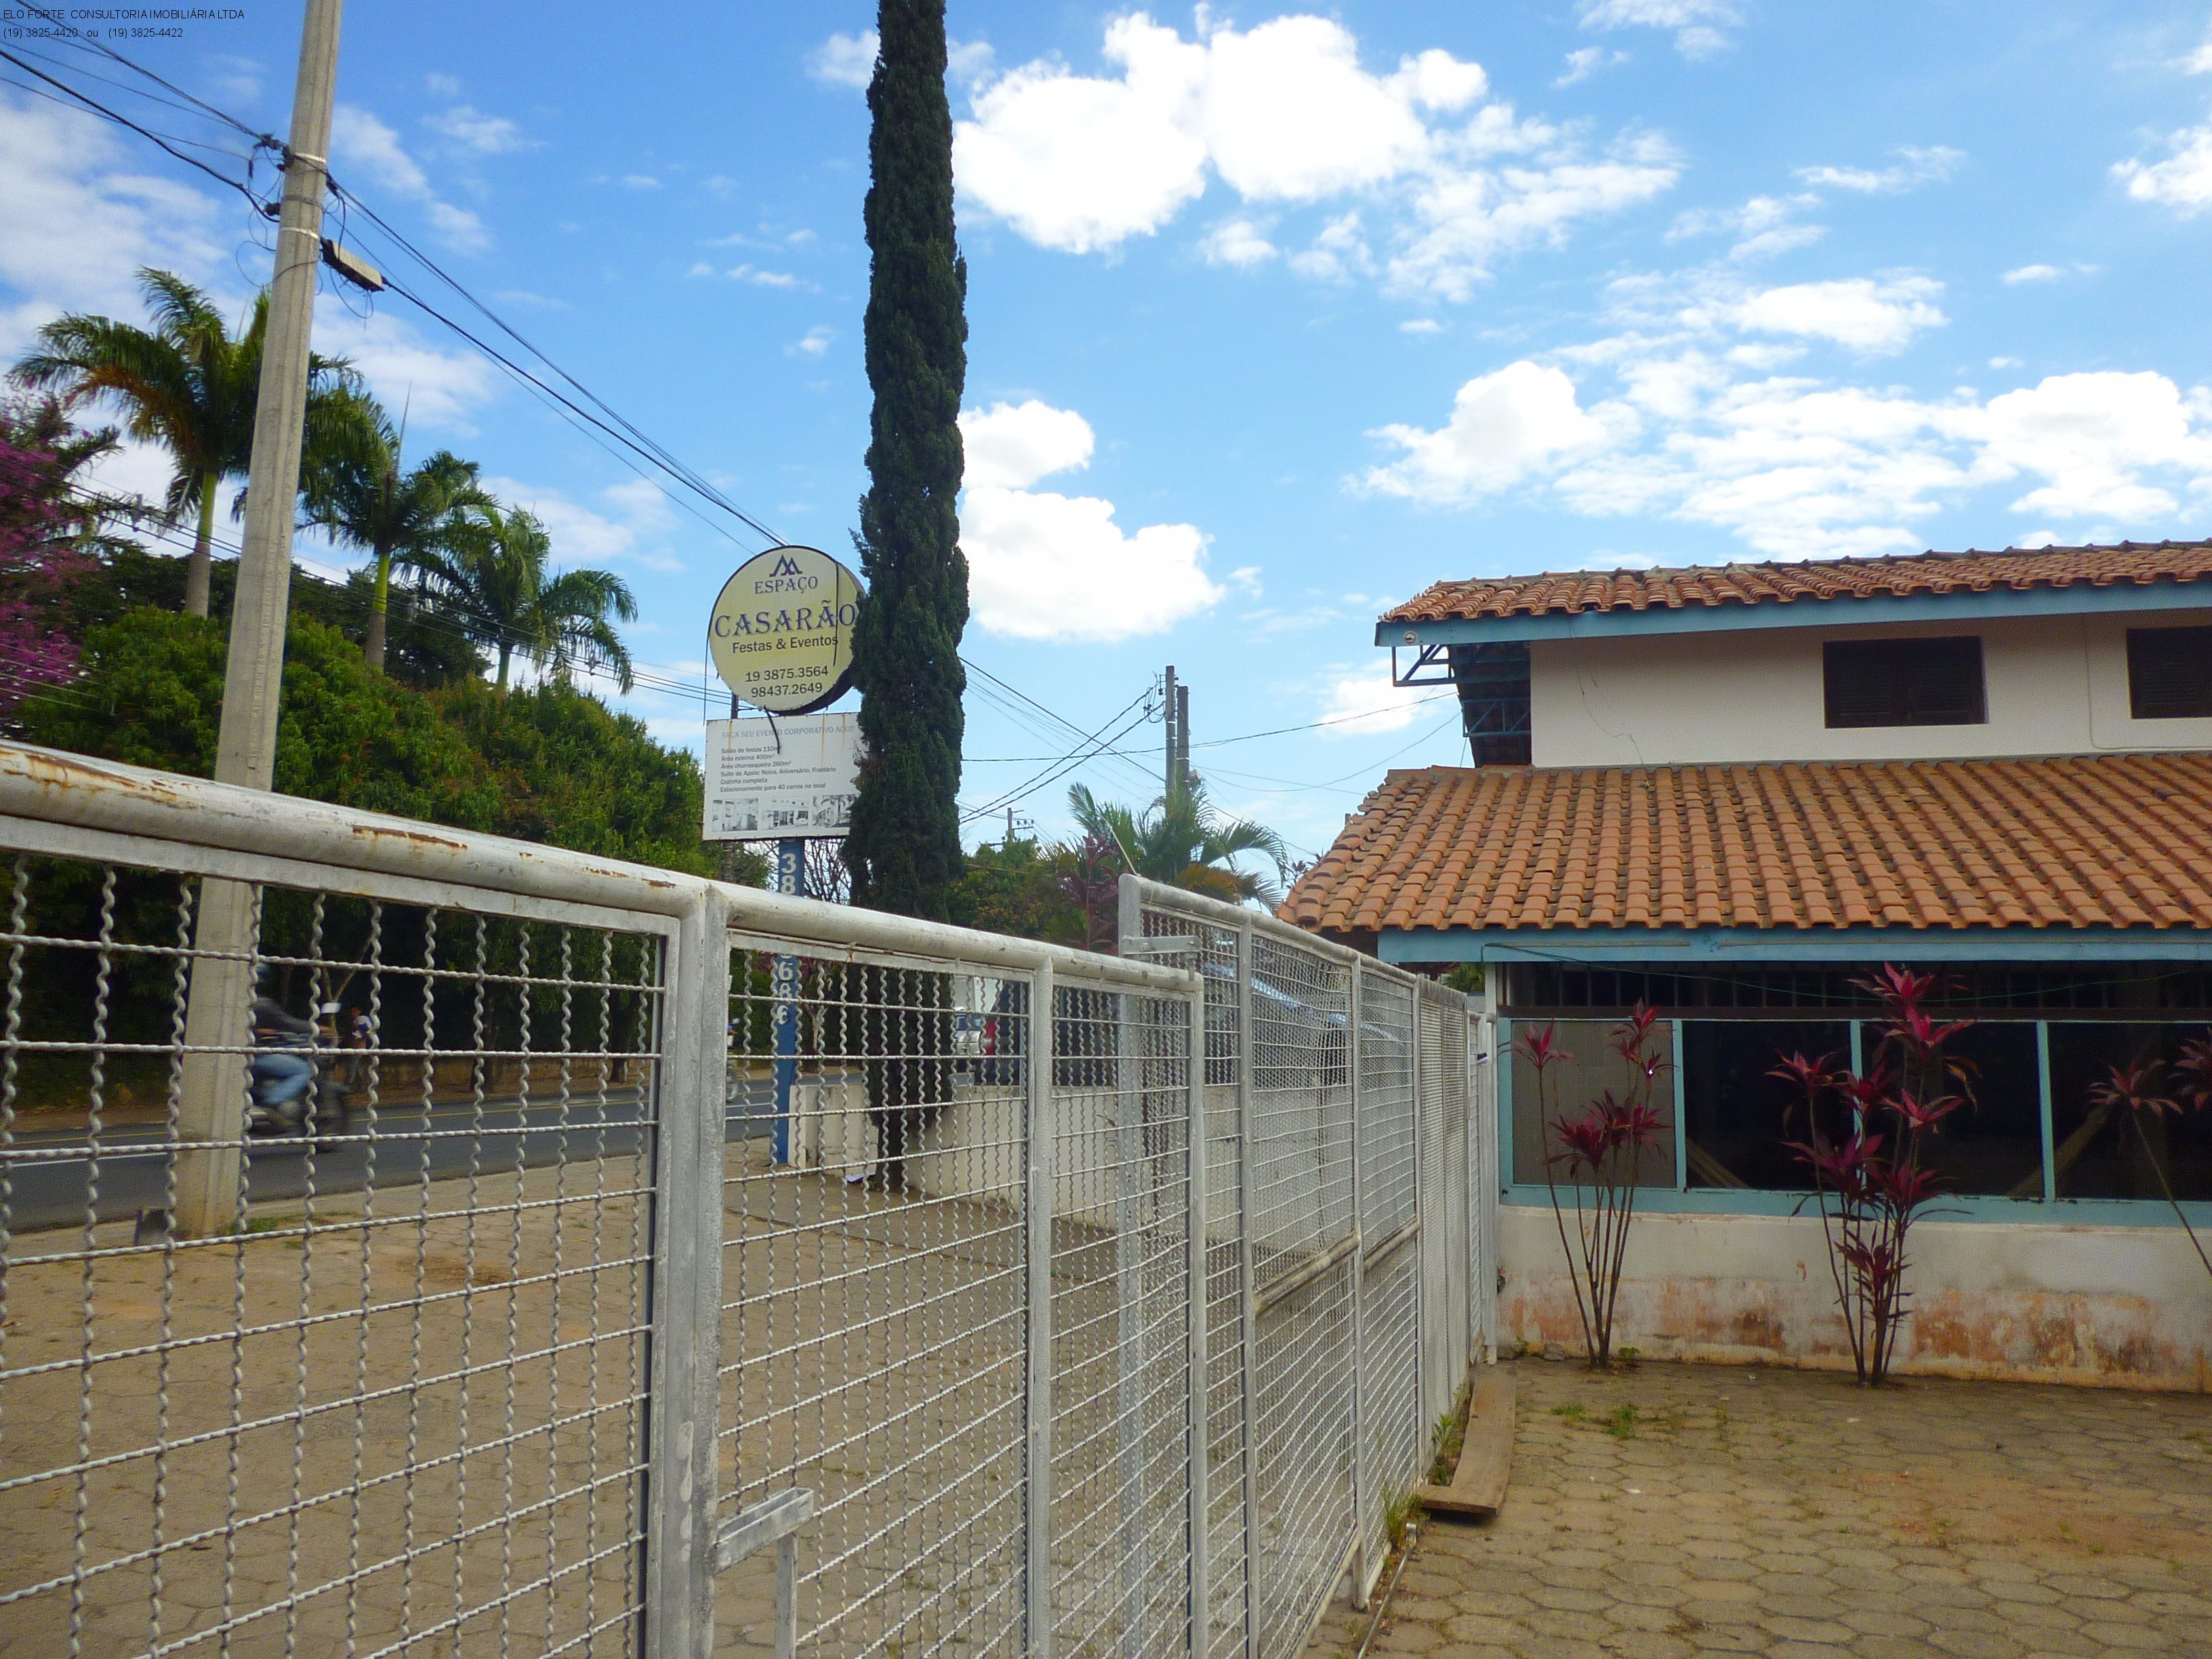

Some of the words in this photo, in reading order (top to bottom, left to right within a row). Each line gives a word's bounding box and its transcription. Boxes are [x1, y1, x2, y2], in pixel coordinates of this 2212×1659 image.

[754, 576, 818, 594] ESPAÇO
[714, 599, 857, 638] CASARÃO
[733, 639, 772, 654] Festas
[776, 638, 786, 650] &
[790, 635, 838, 649] Eventos
[745, 670, 760, 682] 19
[764, 665, 829, 681] 3875.3564
[751, 682, 823, 698] 98437.2649
[756, 729, 782, 737] EVENO
